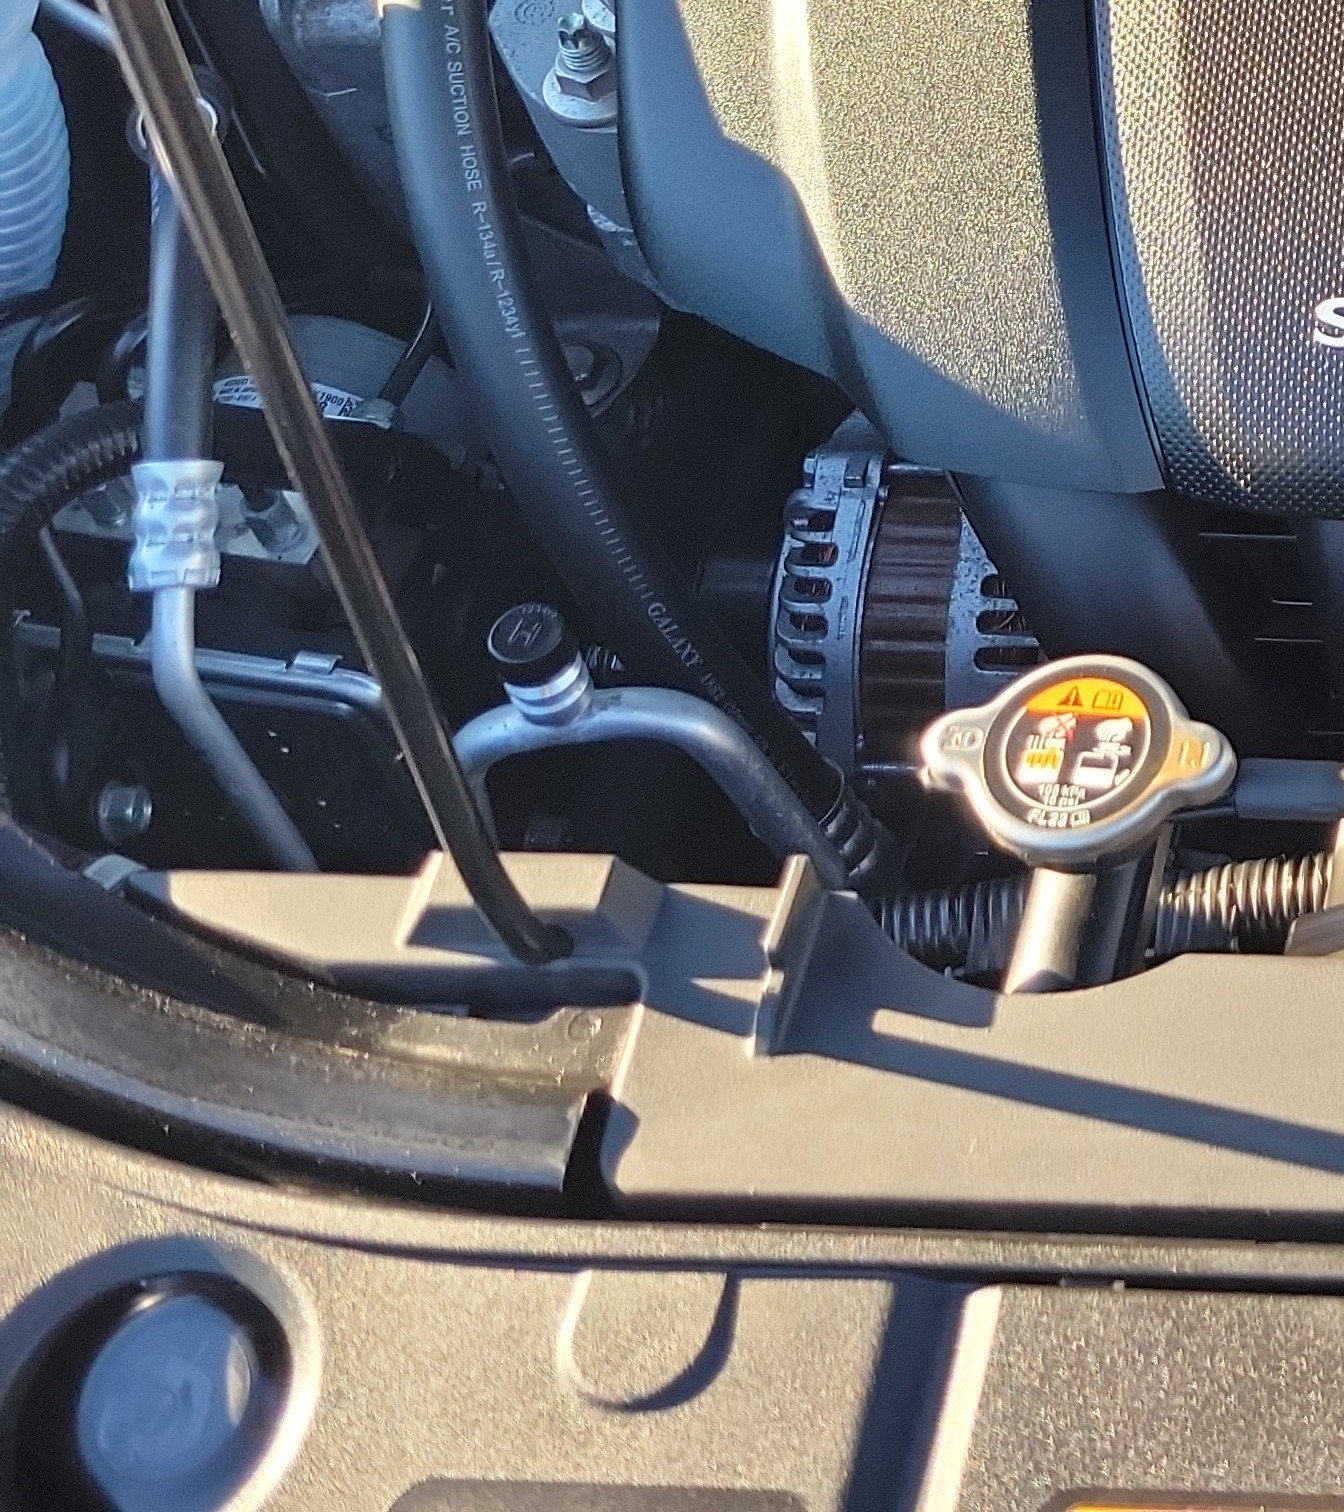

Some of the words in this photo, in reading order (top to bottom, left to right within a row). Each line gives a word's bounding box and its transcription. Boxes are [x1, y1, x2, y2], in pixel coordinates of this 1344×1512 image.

[444, 24, 460, 55] A/C
[449, 61, 472, 136] SUCTION
[460, 145, 483, 192] HOSE
